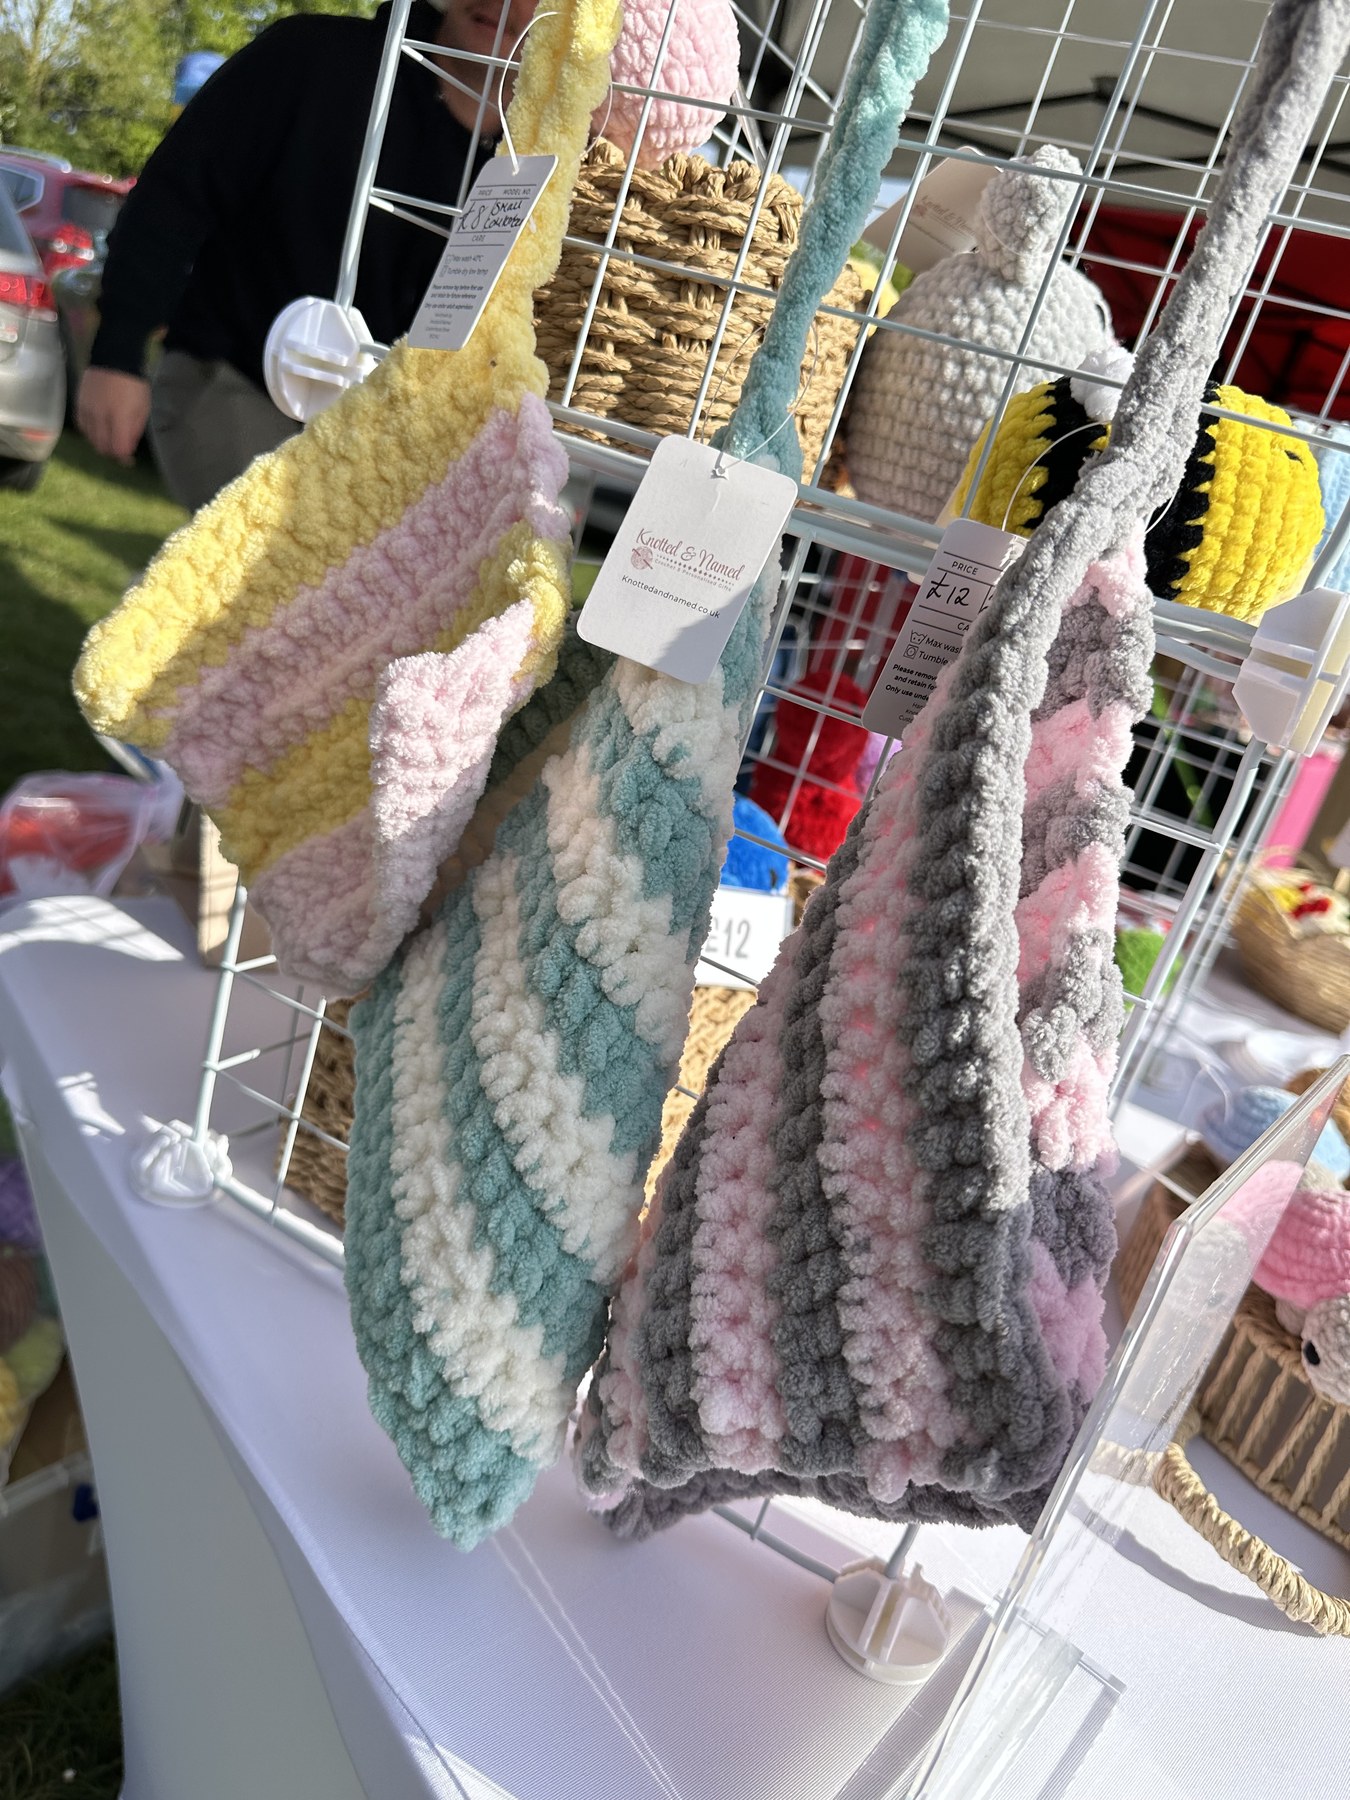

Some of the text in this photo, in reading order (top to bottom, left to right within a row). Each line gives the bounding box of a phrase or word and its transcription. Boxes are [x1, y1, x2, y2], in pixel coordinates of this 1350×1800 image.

[636, 528, 745, 581] Knotted & Named
[951, 560, 979, 576] PRICE
[621, 574, 721, 619] Knottedandnamed.co.uk
[926, 572, 970, 607] £12
[957, 622, 970, 631] CA
[925, 637, 942, 649] Max
[918, 650, 949, 666] Tumble
[893, 663, 914, 675] Please
[894, 675, 908, 683] and
[908, 679, 927, 688] retain
[885, 684, 901, 695] Only
[901, 689, 913, 697] use
